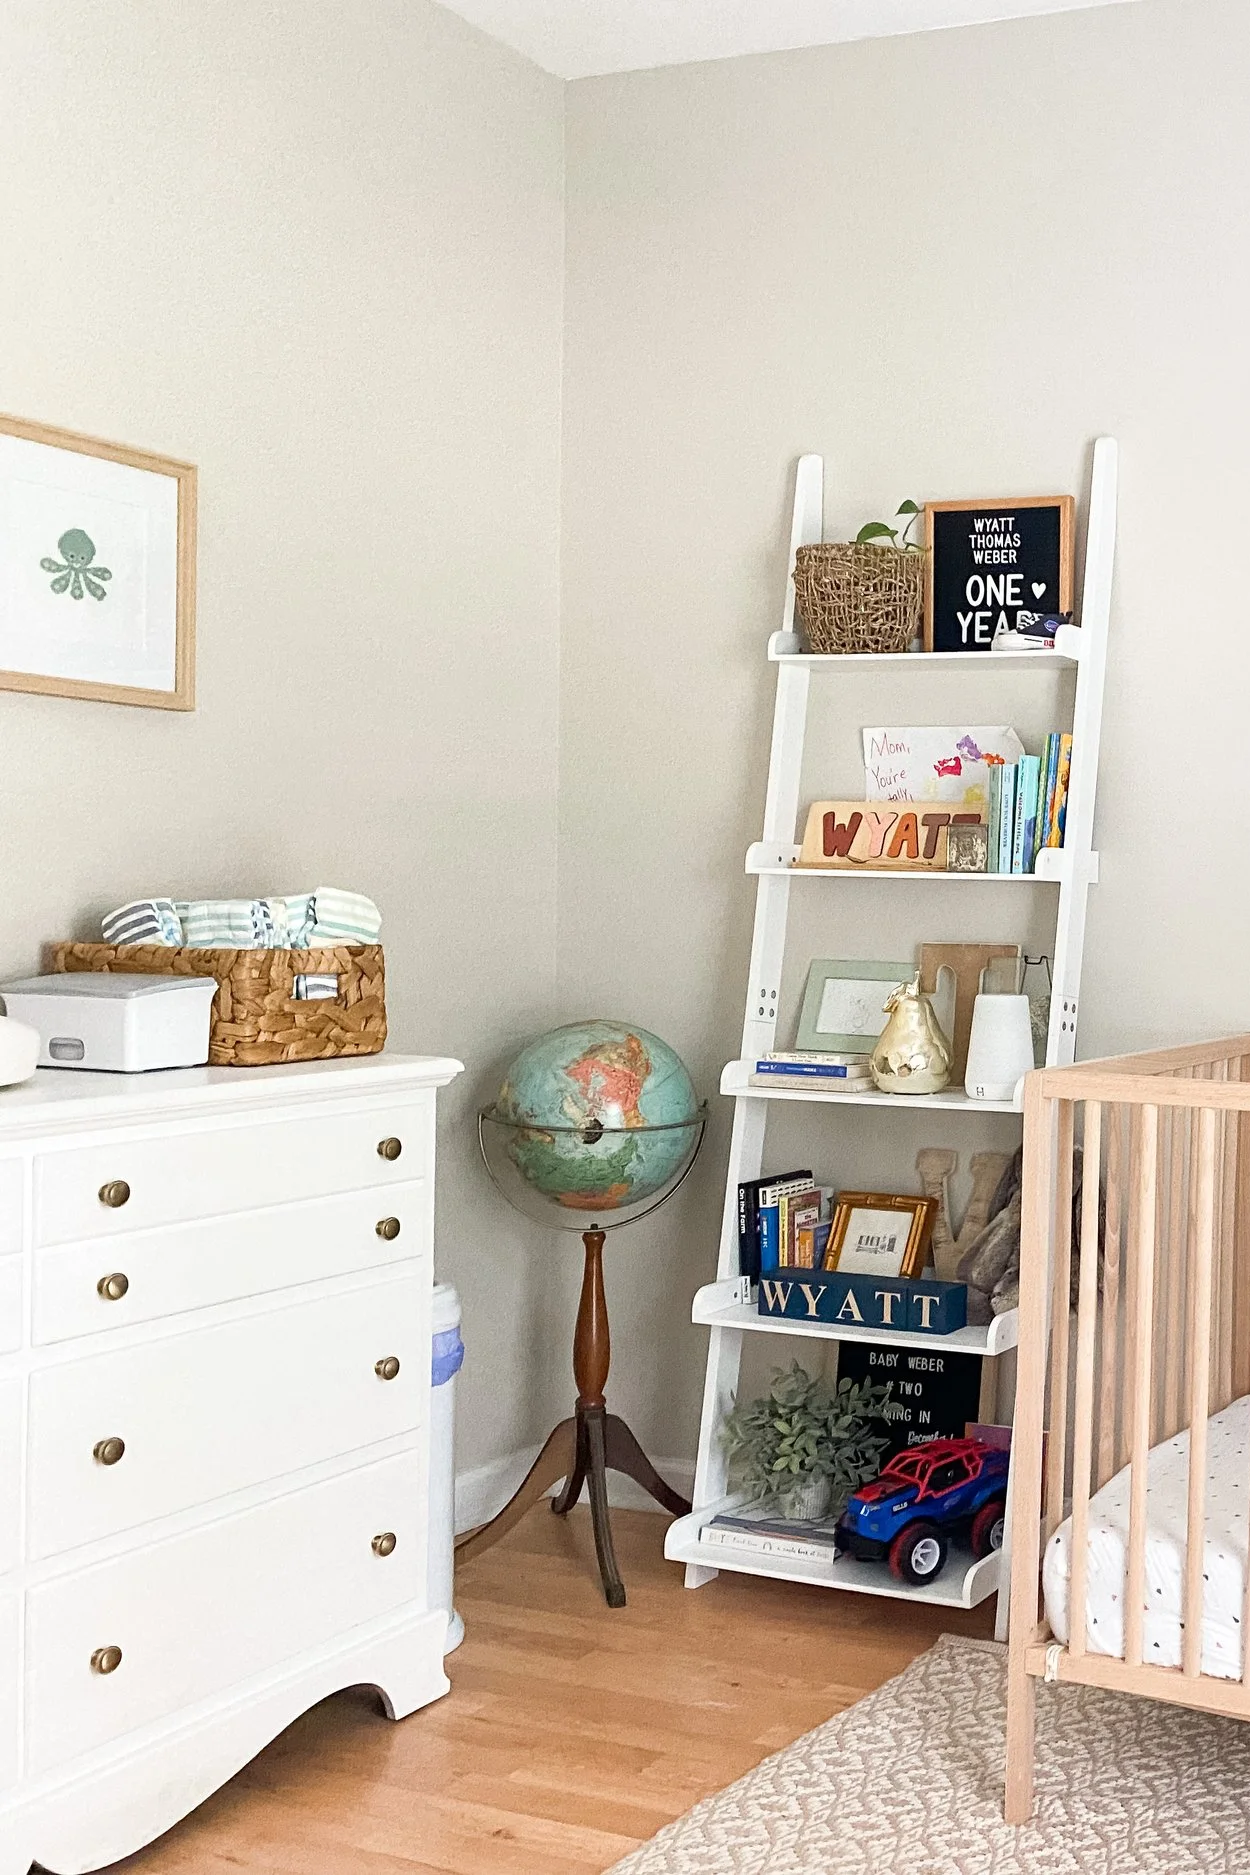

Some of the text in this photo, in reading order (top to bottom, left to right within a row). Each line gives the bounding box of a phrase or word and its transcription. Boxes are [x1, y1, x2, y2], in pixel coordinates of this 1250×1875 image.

[974, 517, 1015, 532] WYATT
[969, 533, 1021, 548] THOMAS
[973, 549, 1017, 564] WEBER
[966, 574, 1024, 607] ONE
[871, 732, 910, 759] Mom,
[872, 766, 907, 790] You're
[823, 811, 981, 859] WYAT
[761, 1279, 940, 1328] WYATT
[869, 1352, 944, 1372] BABY WEBER
[899, 1381, 923, 1397] TWO
[919, 1410, 931, 1424] IN
